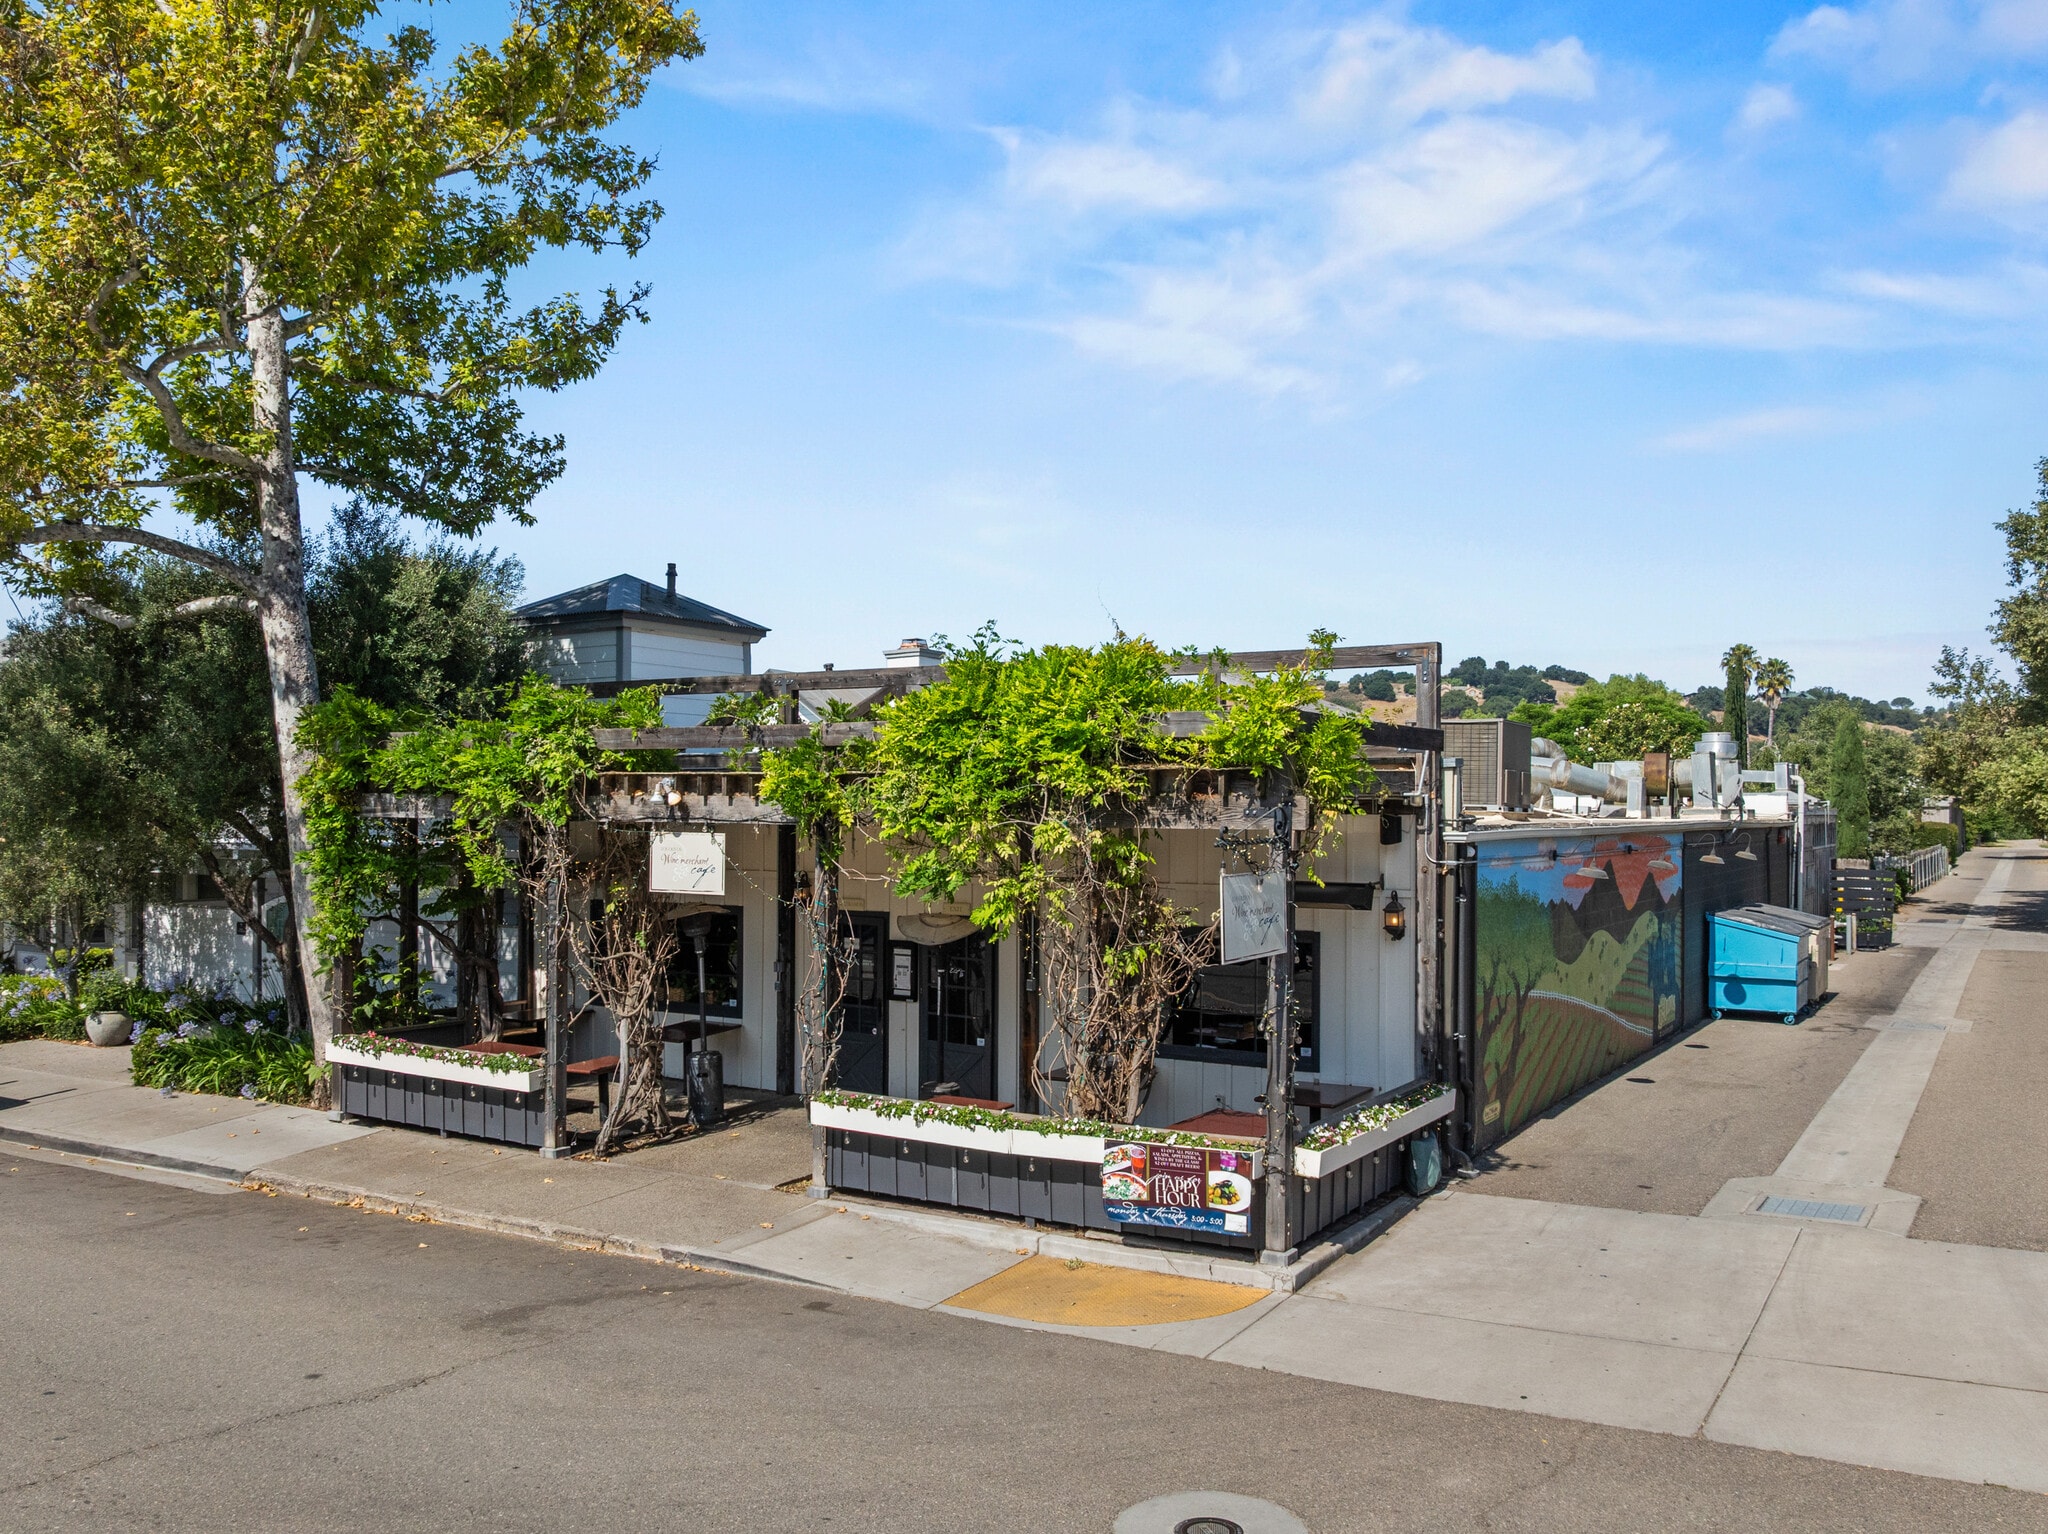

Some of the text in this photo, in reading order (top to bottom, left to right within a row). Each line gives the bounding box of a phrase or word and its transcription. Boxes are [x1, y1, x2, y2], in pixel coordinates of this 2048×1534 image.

[661, 852, 679, 865] Wine
[1155, 1177, 1201, 1195] HAPPY
[1156, 1190, 1201, 1208] HOUR
[1209, 1218, 1224, 1226] 5:00
